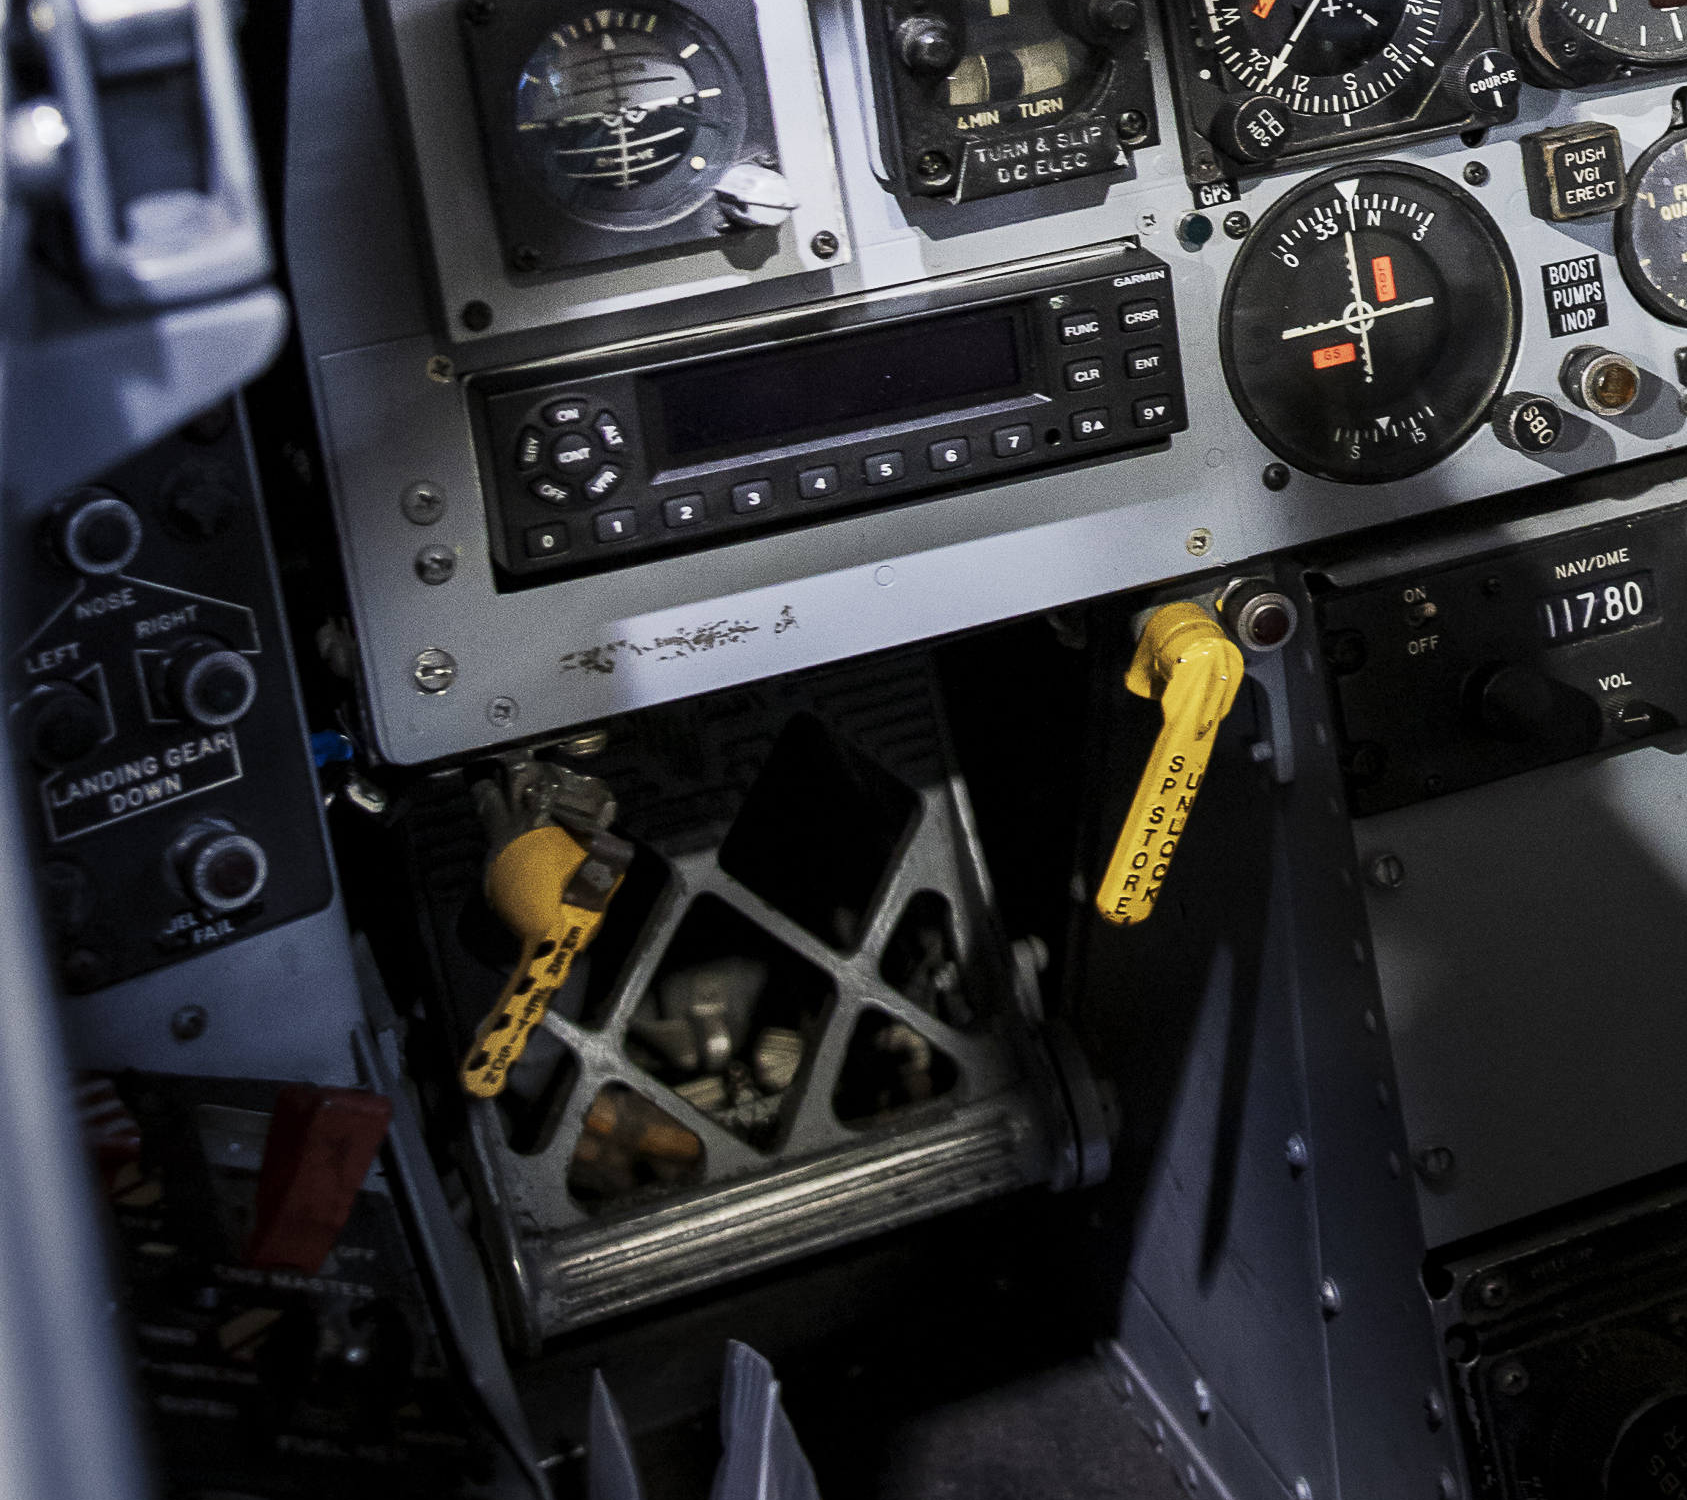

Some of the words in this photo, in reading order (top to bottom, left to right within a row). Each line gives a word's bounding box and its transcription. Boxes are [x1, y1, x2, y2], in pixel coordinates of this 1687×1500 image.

[1469, 68, 1518, 94] COURSE
[969, 109, 999, 129] MIN
[1018, 97, 1064, 119] TURN
[973, 140, 1029, 163] TURN
[1057, 126, 1101, 149] SLIP
[1564, 146, 1606, 167] PUSH
[1036, 152, 1087, 175] ELEC
[1574, 169, 1600, 184] VGI
[1200, 183, 1232, 206] GPS
[1565, 180, 1616, 204] ERECT
[1315, 218, 1339, 241] 33
[1367, 210, 1381, 227] N
[1113, 269, 1165, 288] GARMIN
[1548, 258, 1596, 285] BOOST
[1552, 281, 1602, 309] PUMPS
[1125, 308, 1159, 325] CRSR
[1561, 308, 1596, 332] INOP
[1064, 321, 1099, 337] FUNC
[1134, 355, 1159, 370] ENT
[1073, 368, 1100, 383] CLR
[1522, 405, 1559, 445] OBS
[1554, 547, 1631, 580] NAV/DME
[73, 587, 137, 620] NOSE
[1403, 586, 1427, 603] ON
[1545, 580, 1643, 638] 117.80
[134, 604, 199, 639] RIGHT
[1408, 635, 1440, 655] OFF
[26, 642, 80, 673] LEFT
[1598, 672, 1632, 691] VOL
[51, 756, 159, 807] LANDING
[164, 731, 232, 768] GEAR
[107, 773, 183, 814] DOWN
[1141, 773, 1202, 902] UNLOCK
[1115, 806, 1165, 915] STORE
